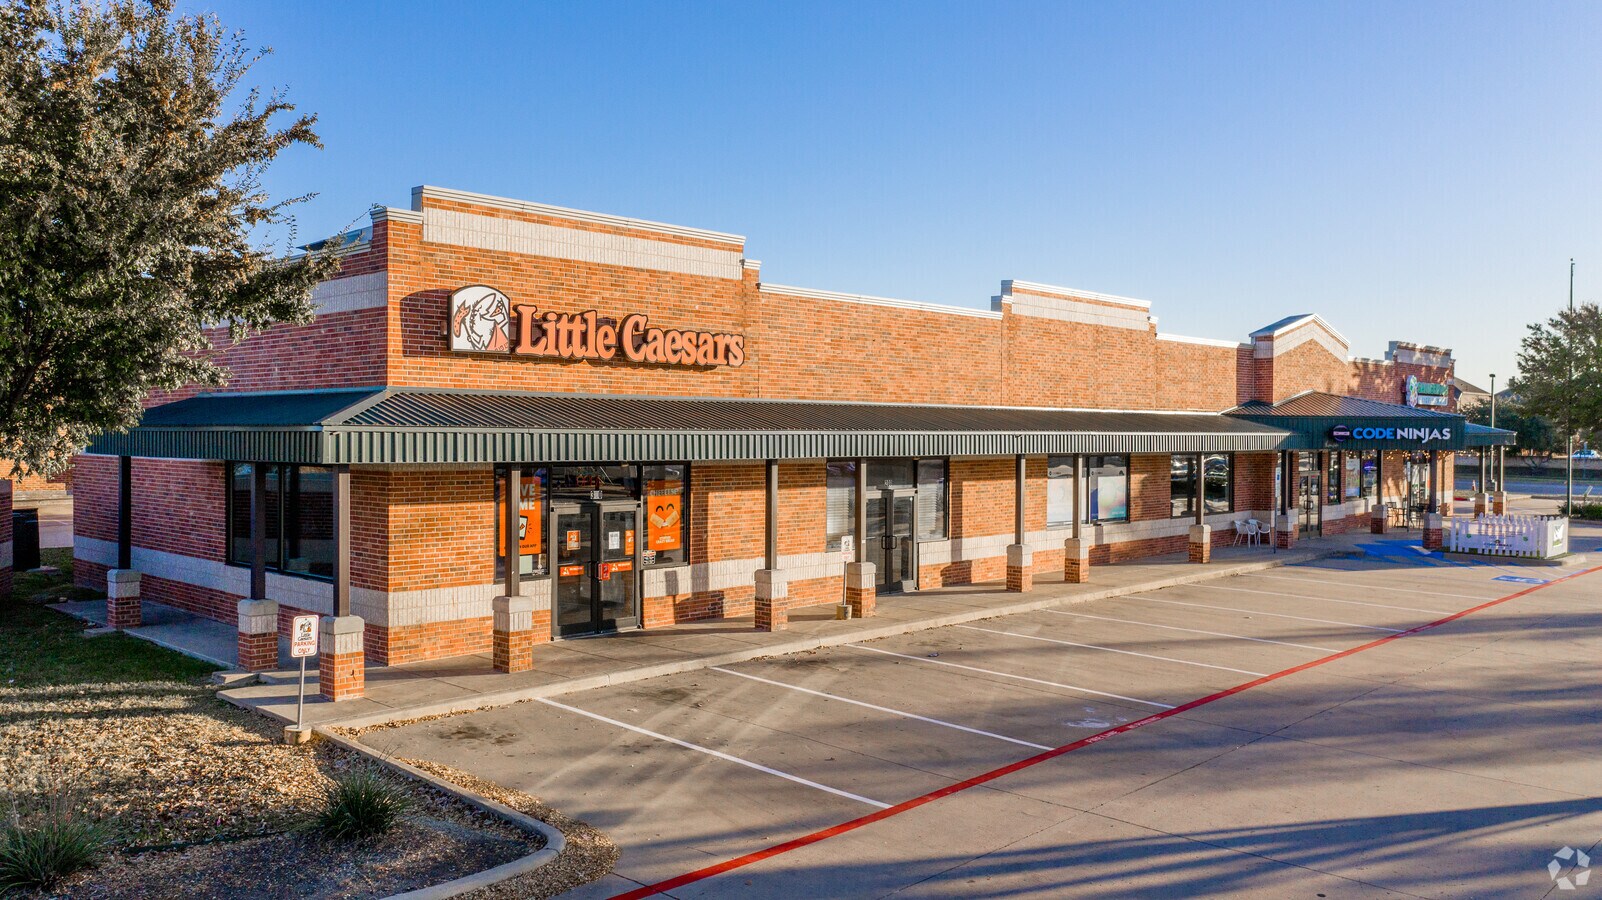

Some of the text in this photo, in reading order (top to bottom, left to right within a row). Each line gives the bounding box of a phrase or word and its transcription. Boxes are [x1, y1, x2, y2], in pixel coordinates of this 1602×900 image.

[515, 304, 745, 367] Little Caesars
[1352, 427, 1451, 444] CODE NINJAS
